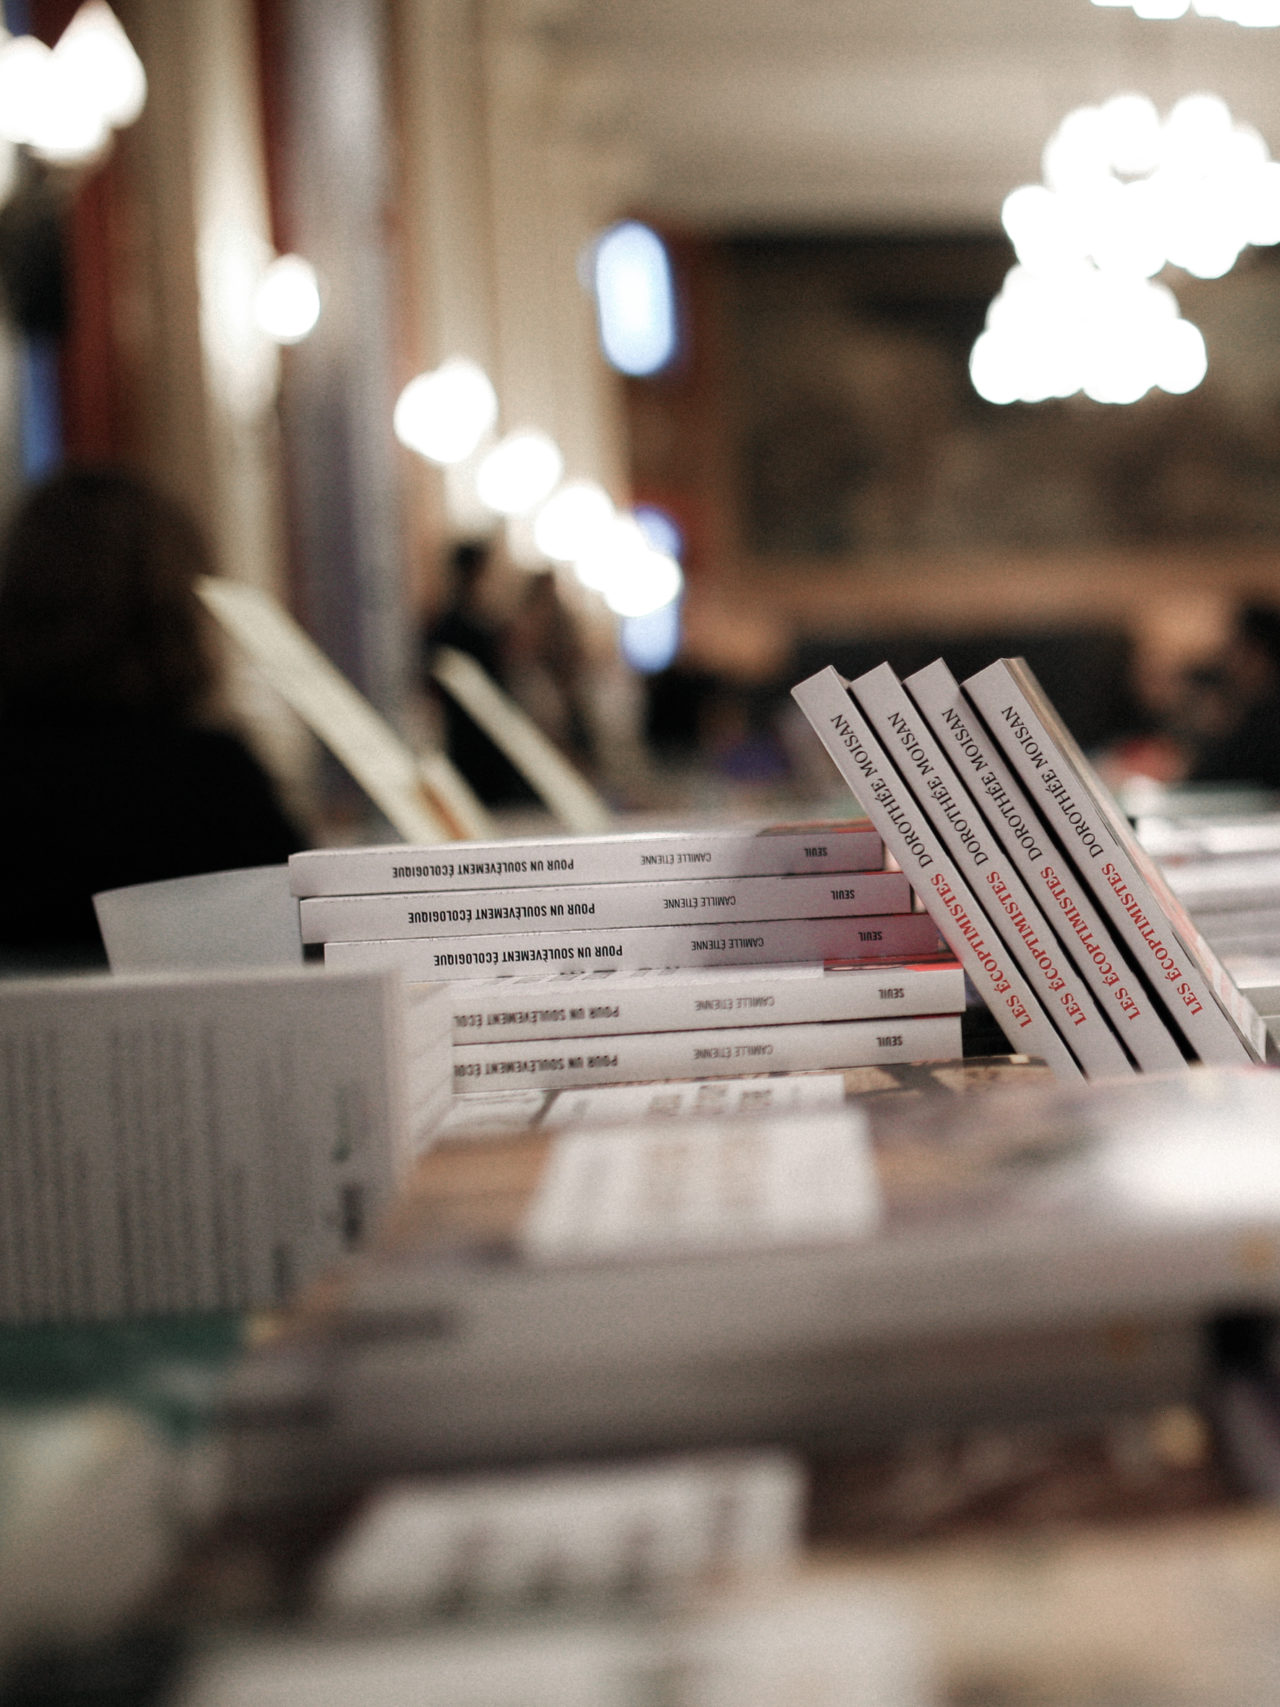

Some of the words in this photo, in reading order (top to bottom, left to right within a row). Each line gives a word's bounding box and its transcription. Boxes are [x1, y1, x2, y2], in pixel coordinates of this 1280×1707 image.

[887, 711, 934, 777] MOISAN
[941, 707, 989, 772] MOISAN
[1001, 705, 1049, 769] MOISAN
[830, 713, 879, 778] MOISAN
[926, 775, 989, 867] DOROTHÉE
[981, 771, 1044, 862] DOROTHÉE
[1041, 768, 1105, 859] DOROTHÉE
[870, 777, 934, 869] DOROTHÉE
[640, 854, 675, 866] ÉTIENNE
[677, 852, 712, 864] CAMILLE
[804, 847, 828, 858] SEUIL
[392, 864, 455, 879] ÉCOLOGIQUE
[457, 860, 527, 877] SOULÈVEMENT
[529, 860, 544, 872] UN
[546, 858, 575, 871] POUR
[700, 895, 737, 907] CAMILLE
[830, 889, 856, 901] SEUIL
[550, 904, 565, 916] UN
[567, 902, 595, 915] POUR
[663, 897, 699, 910] ÉTIENNE
[408, 909, 472, 924] ÉCOLOGIQUE
[475, 905, 547, 921] SOULÈVEMENT
[1039, 866, 1121, 987] ÉCOPTIMISTES
[1101, 863, 1183, 983] ÉCOPTIMISTES
[857, 931, 883, 942] SEUIL
[930, 872, 1012, 994] ÉCOPTIMISTES
[986, 871, 1067, 993] ÉCOPTIMISTES
[691, 939, 727, 952] ÉTIENNE
[728, 937, 765, 949] CAMILLE
[433, 951, 499, 967] ÉCOLOGIQUE
[501, 947, 575, 963] SOULÈVEMENT
[577, 946, 592, 959] UN
[594, 945, 623, 958] POUR
[878, 987, 905, 1000] SEUIL
[1176, 982, 1204, 1016] LES
[736, 995, 776, 1009] CAMILLE
[1060, 992, 1087, 1027] LES
[1114, 987, 1141, 1021] LES
[568, 1007, 586, 1020] UN
[589, 1005, 620, 1019] POUR
[1005, 994, 1033, 1029] LES
[875, 1035, 904, 1048] SEUIL
[735, 1044, 774, 1057] CAMILLE
[567, 1056, 584, 1069] UN
[586, 1054, 619, 1069] POUR
